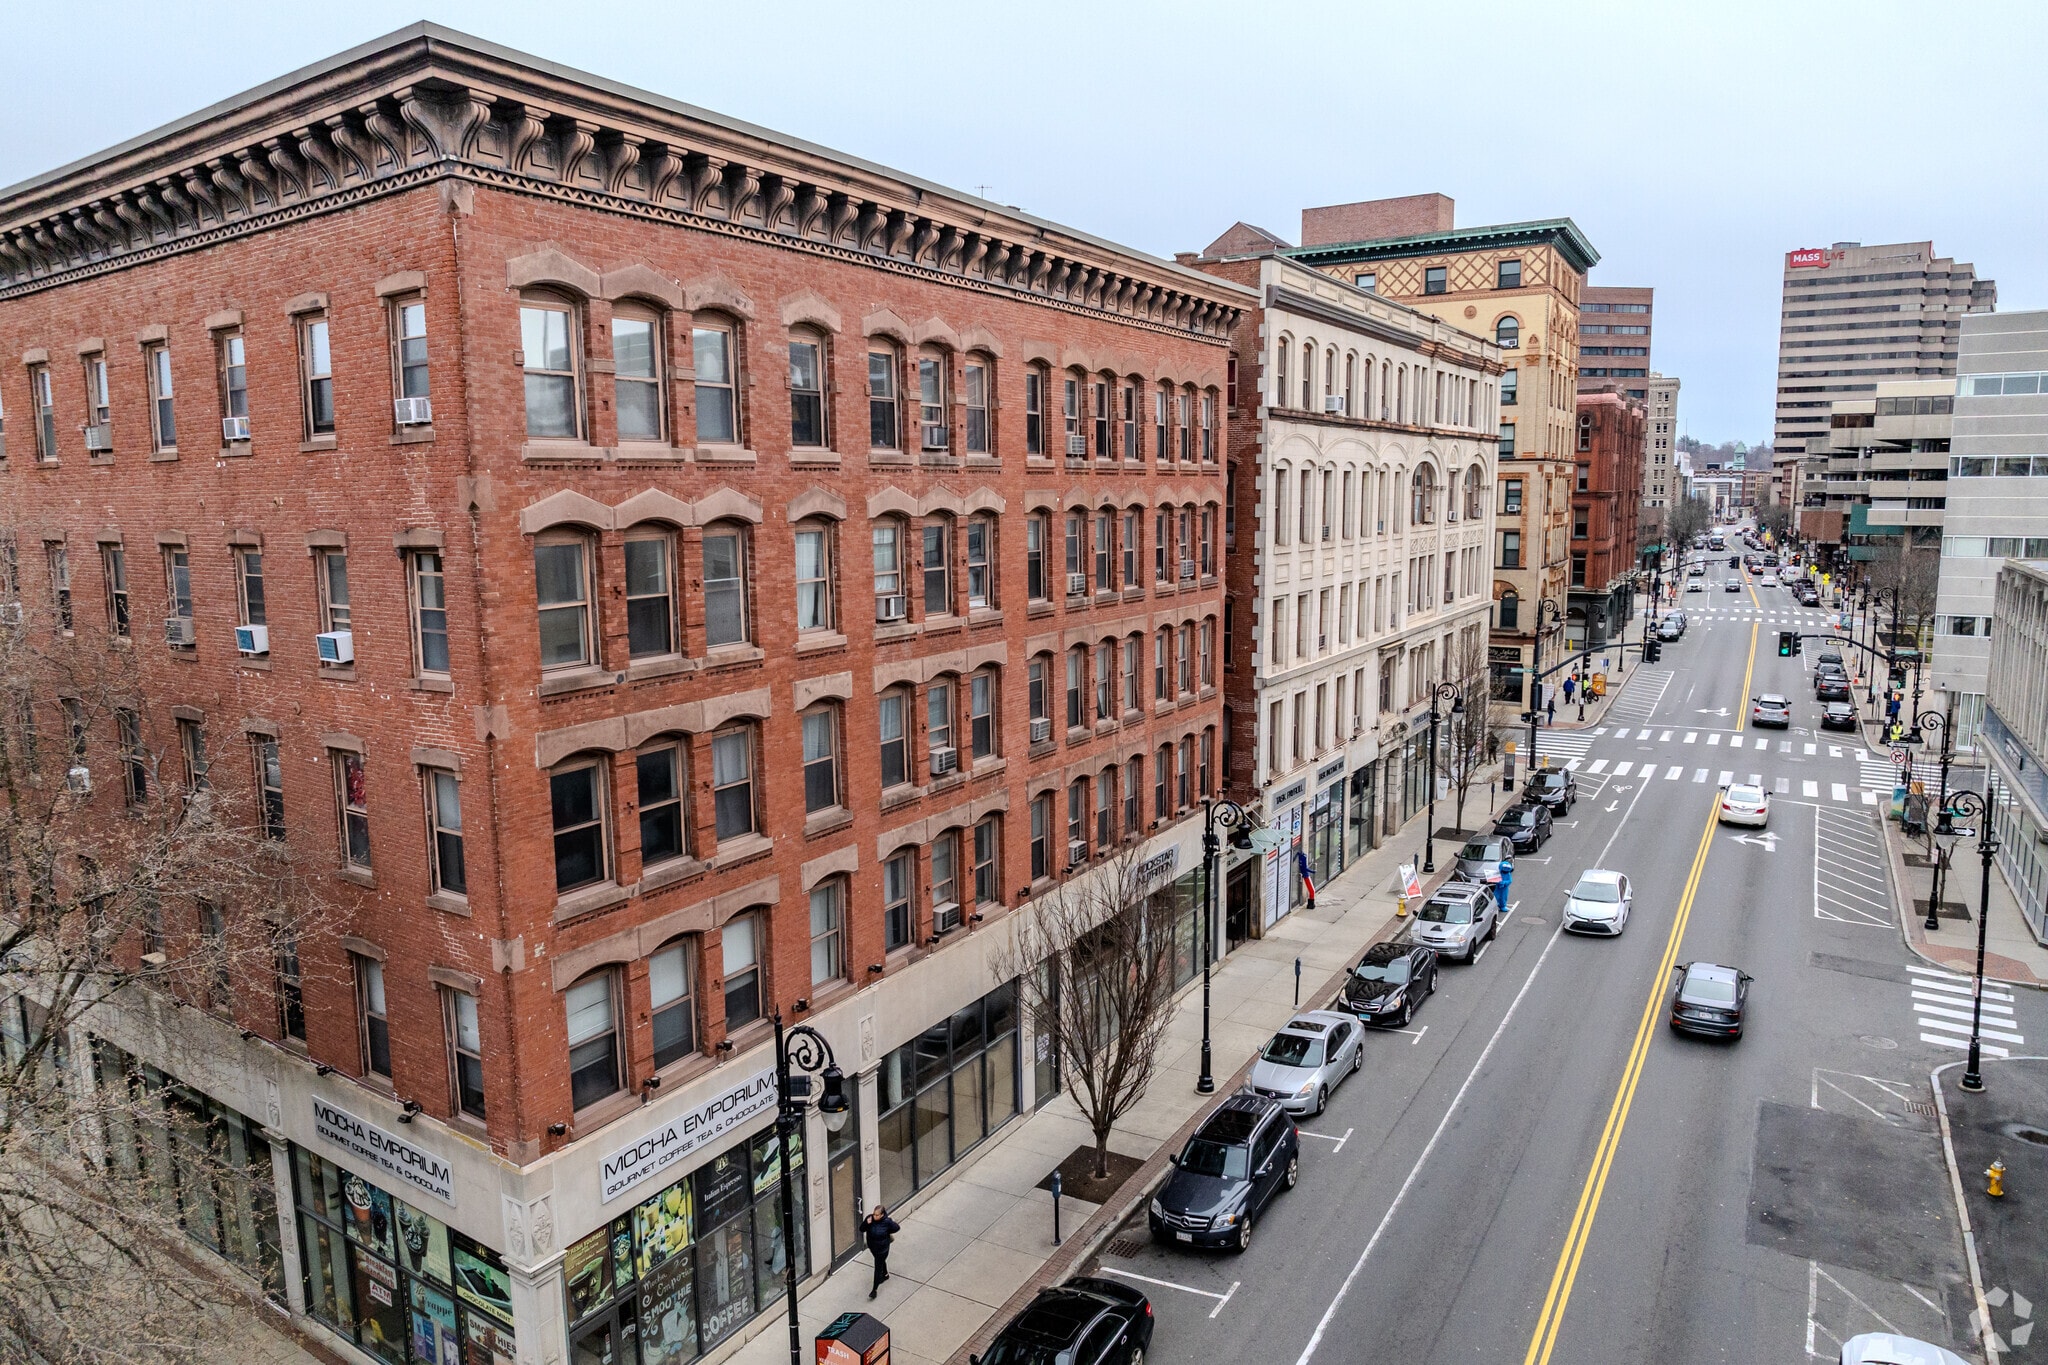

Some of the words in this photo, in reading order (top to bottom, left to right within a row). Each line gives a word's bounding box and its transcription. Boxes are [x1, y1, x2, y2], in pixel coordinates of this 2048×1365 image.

[1793, 253, 1820, 262] MASS
[1825, 251, 1845, 261] LIVE
[604, 1127, 678, 1180] MOCHA
[683, 1072, 774, 1136] EMPORIUM
[314, 1103, 365, 1141] MOCHA
[369, 1130, 450, 1184] EMPORIUM
[607, 1160, 656, 1195] GOURMET
[658, 1139, 694, 1166] COFFEE
[696, 1129, 713, 1143] TEA
[715, 1123, 723, 1132] &
[725, 1093, 774, 1127] CHOCOLATE
[317, 1124, 351, 1147] GOURMET
[352, 1142, 379, 1163] COFFEE
[380, 1158, 395, 1171] TEA
[396, 1167, 403, 1175] &
[404, 1171, 450, 1200] CHOCOLATE
[720, 1174, 742, 1192] Espresso
[365, 1254, 394, 1277] Breakfast
[371, 1283, 392, 1298] ATM
[643, 1272, 668, 1293] Mocha
[462, 1292, 496, 1315] CHOCOLATE
[496, 1311, 511, 1323] MINT
[642, 1282, 692, 1324] SMOOTHIE
[702, 1296, 749, 1342] COFFEE
[469, 1319, 517, 1354] SMOHIES
[827, 1345, 850, 1360] TRASH
